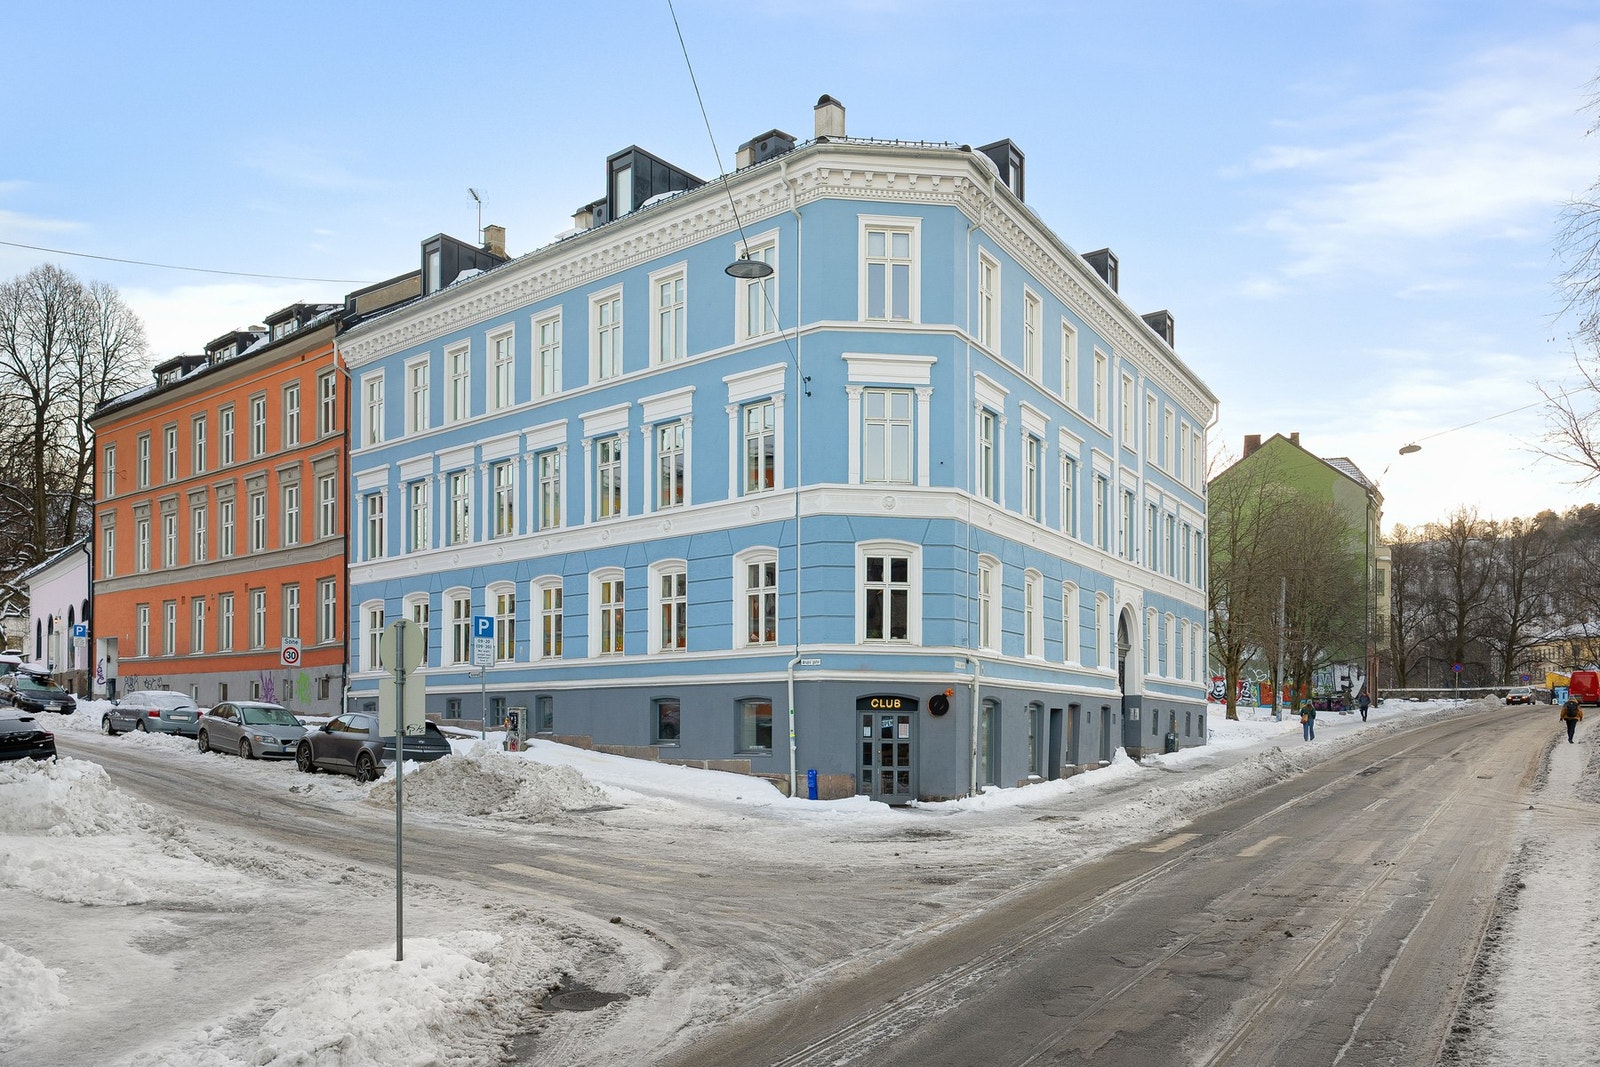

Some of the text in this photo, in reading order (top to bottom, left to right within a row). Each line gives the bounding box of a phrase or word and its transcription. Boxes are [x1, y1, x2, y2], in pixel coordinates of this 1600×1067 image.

[76, 626, 83, 635] P
[478, 618, 490, 634] P
[286, 651, 296, 659] 30
[871, 698, 900, 708] CLUB
